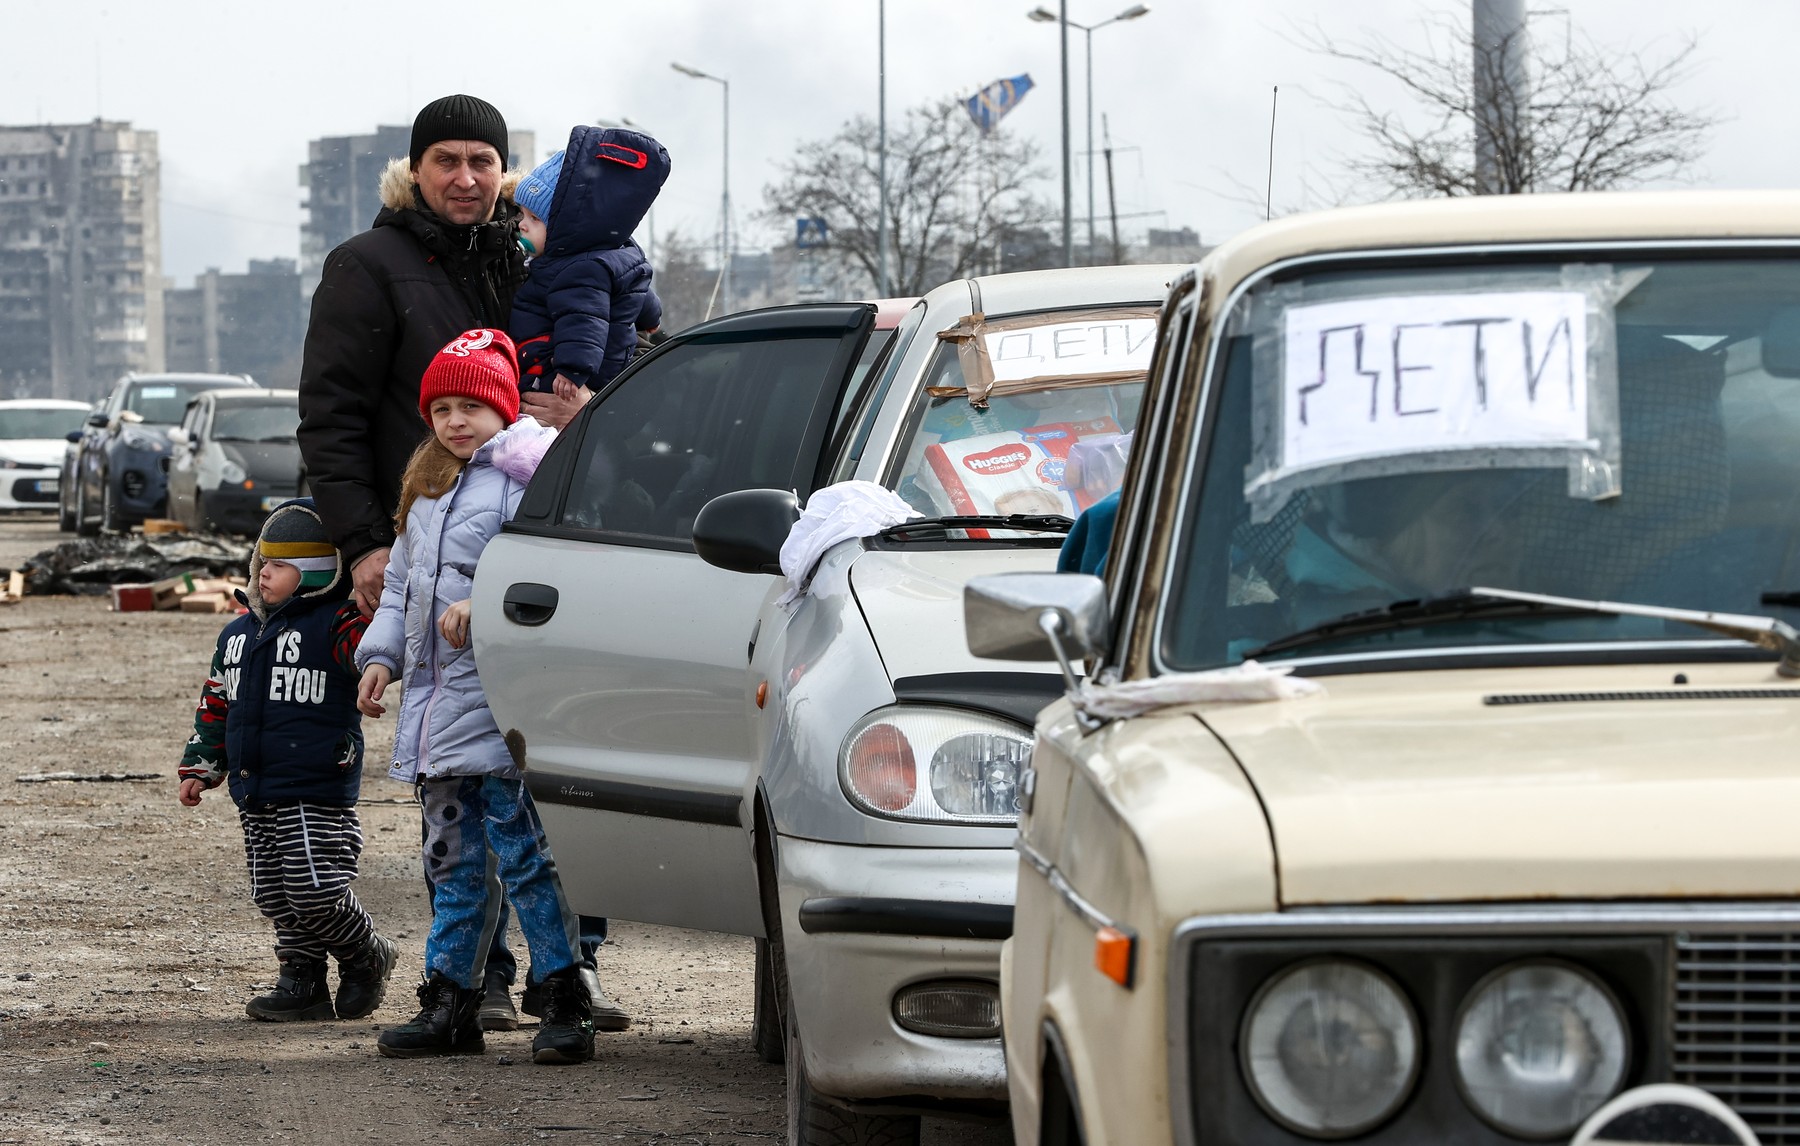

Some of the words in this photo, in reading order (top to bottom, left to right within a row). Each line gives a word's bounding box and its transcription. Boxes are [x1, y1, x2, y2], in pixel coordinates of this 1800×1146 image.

[1297, 316, 1576, 427] ДЕТИ
[968, 451, 1027, 470] HUGGIES
[988, 462, 1016, 472] Classic
[275, 630, 302, 664] YS
[269, 666, 327, 705] EYOU
